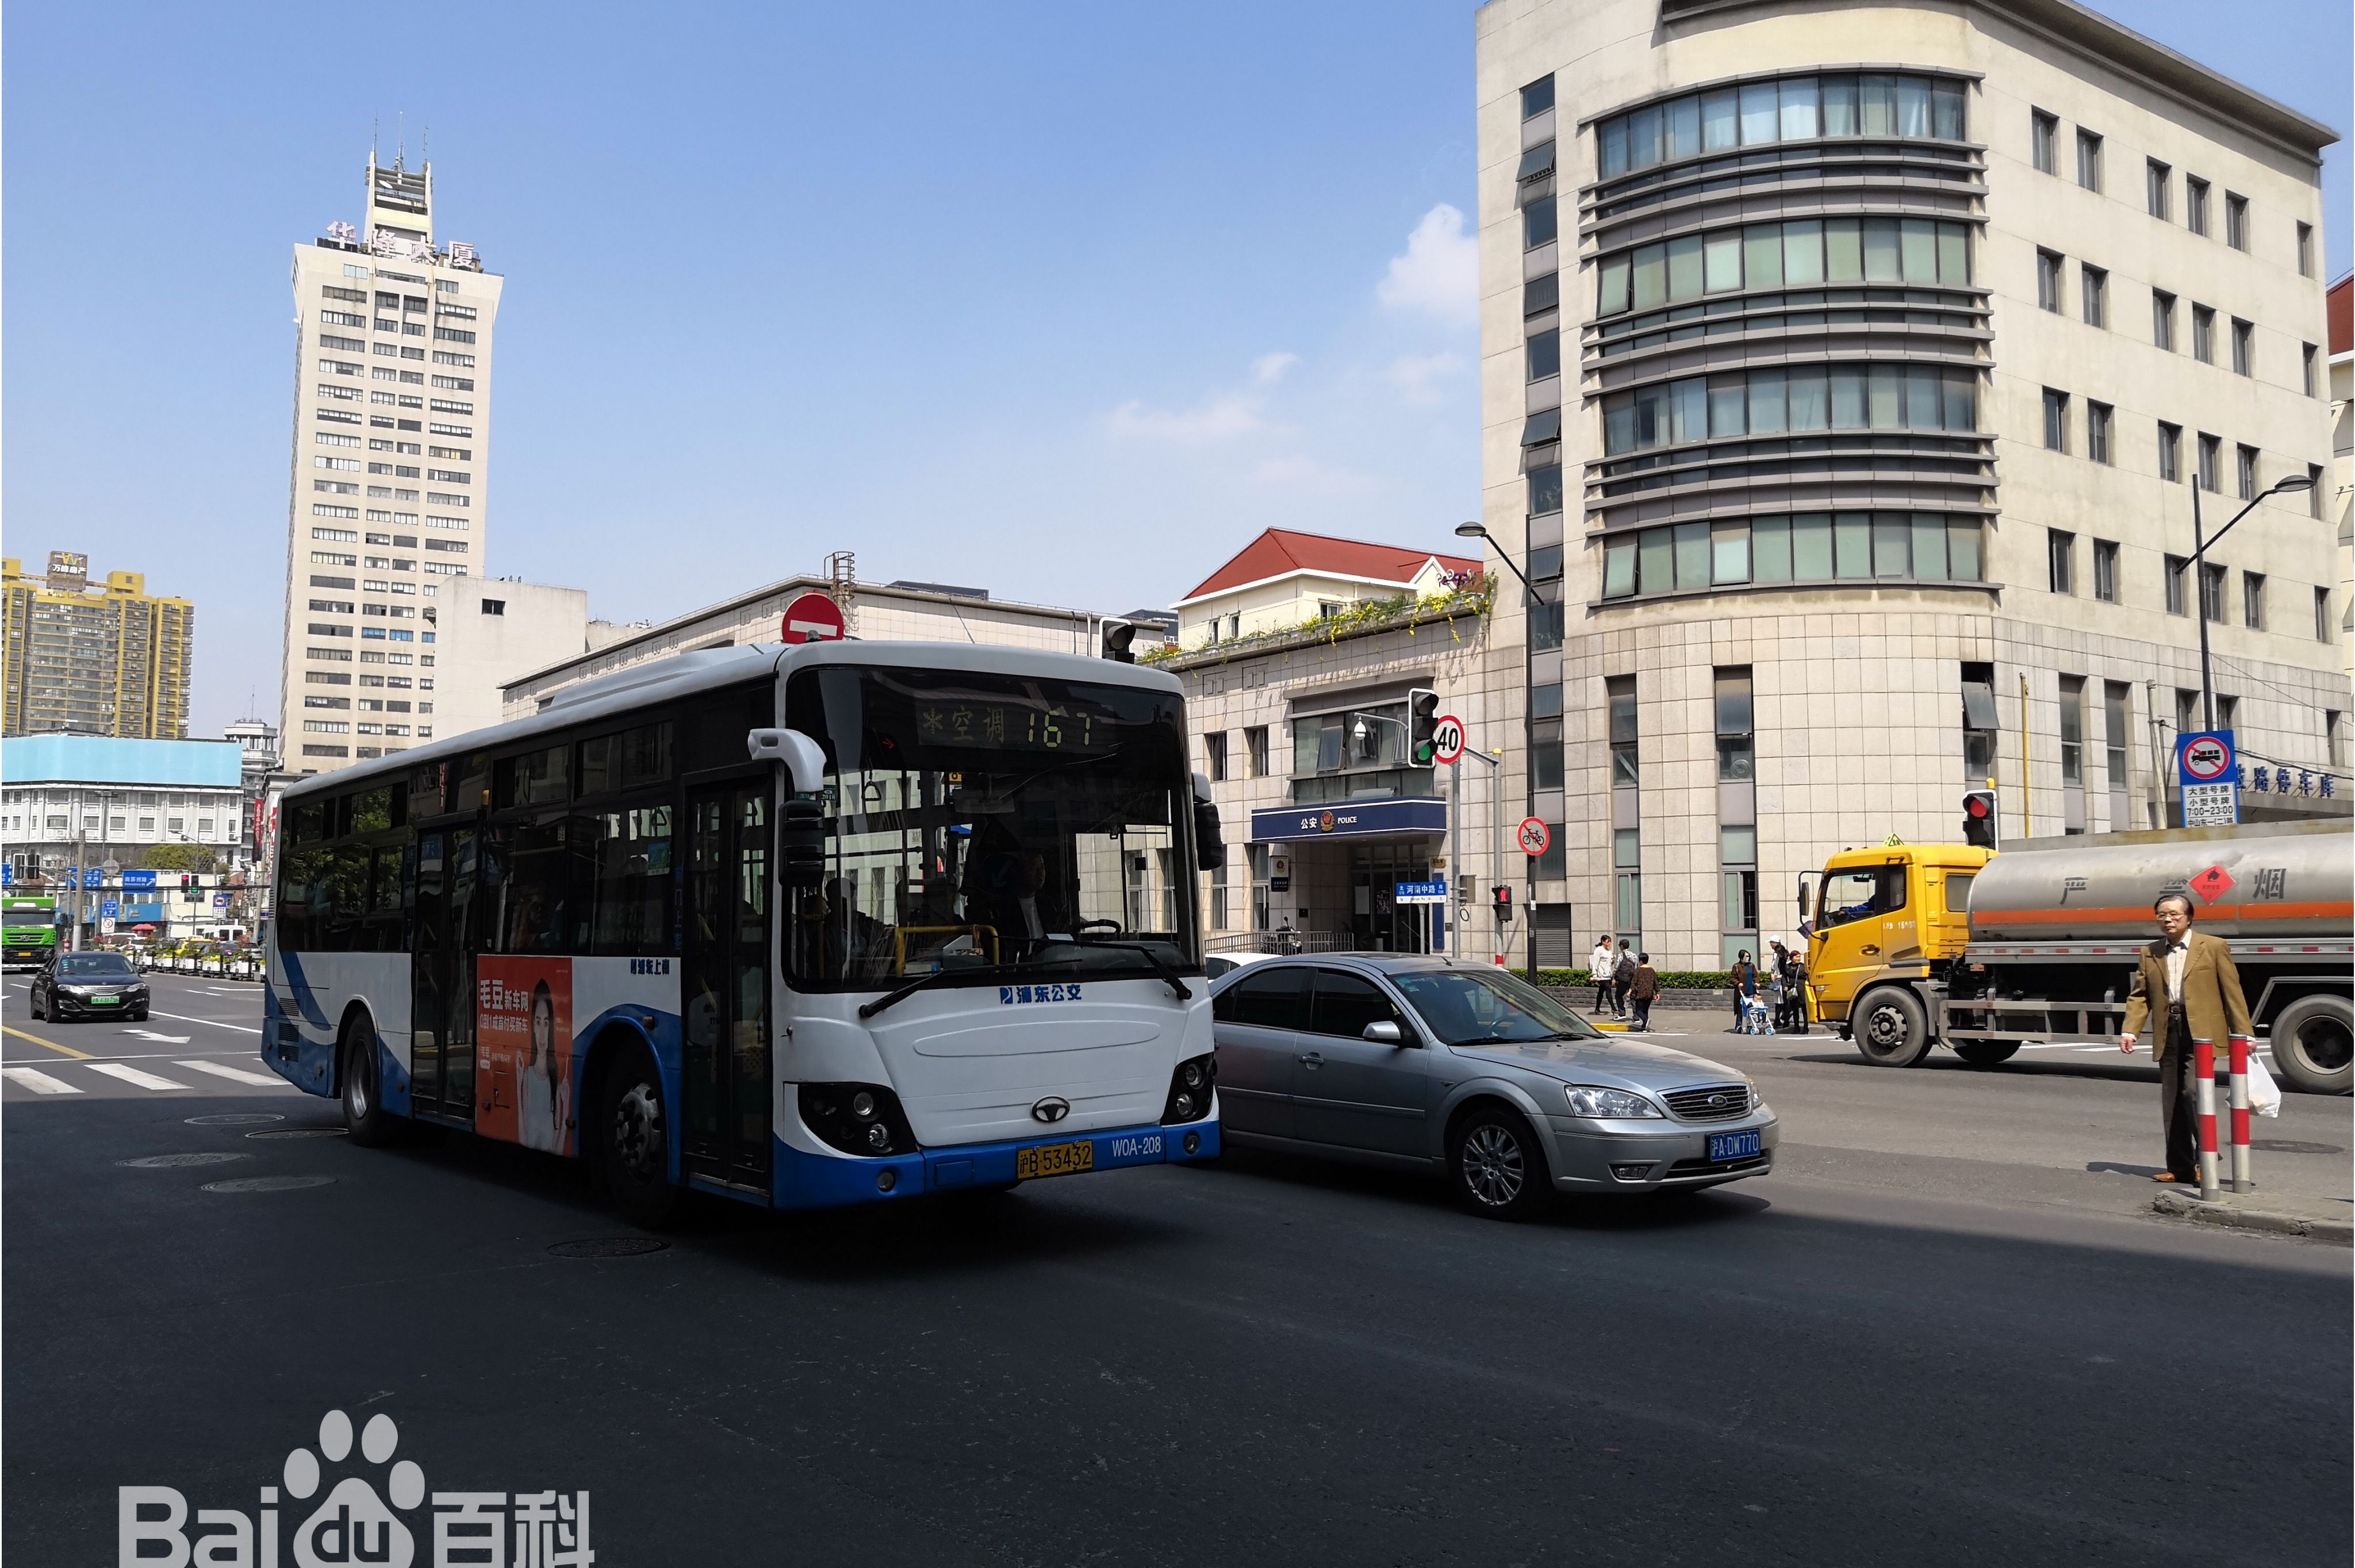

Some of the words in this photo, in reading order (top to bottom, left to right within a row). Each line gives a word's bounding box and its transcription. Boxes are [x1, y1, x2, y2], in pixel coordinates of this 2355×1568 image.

[952, 705, 1004, 744] 空调
[1028, 710, 1091, 747] 167
[1437, 727, 1458, 751] 40
[2188, 785, 2229, 795] 大型号牌
[2189, 796, 2230, 806] 小型号牌
[2187, 805, 2233, 816] 7:00-23:00
[1301, 817, 1317, 829] 公安
[1337, 816, 1357, 824] POLICE
[1406, 885, 1436, 894] 河南中路
[2059, 877, 2088, 905] 严
[2253, 868, 2287, 899] 烟
[480, 979, 528, 1012] 毛豆新车网
[1017, 984, 1082, 1004] 浦东公交
[480, 1016, 528, 1033] 0到1成首付买新车
